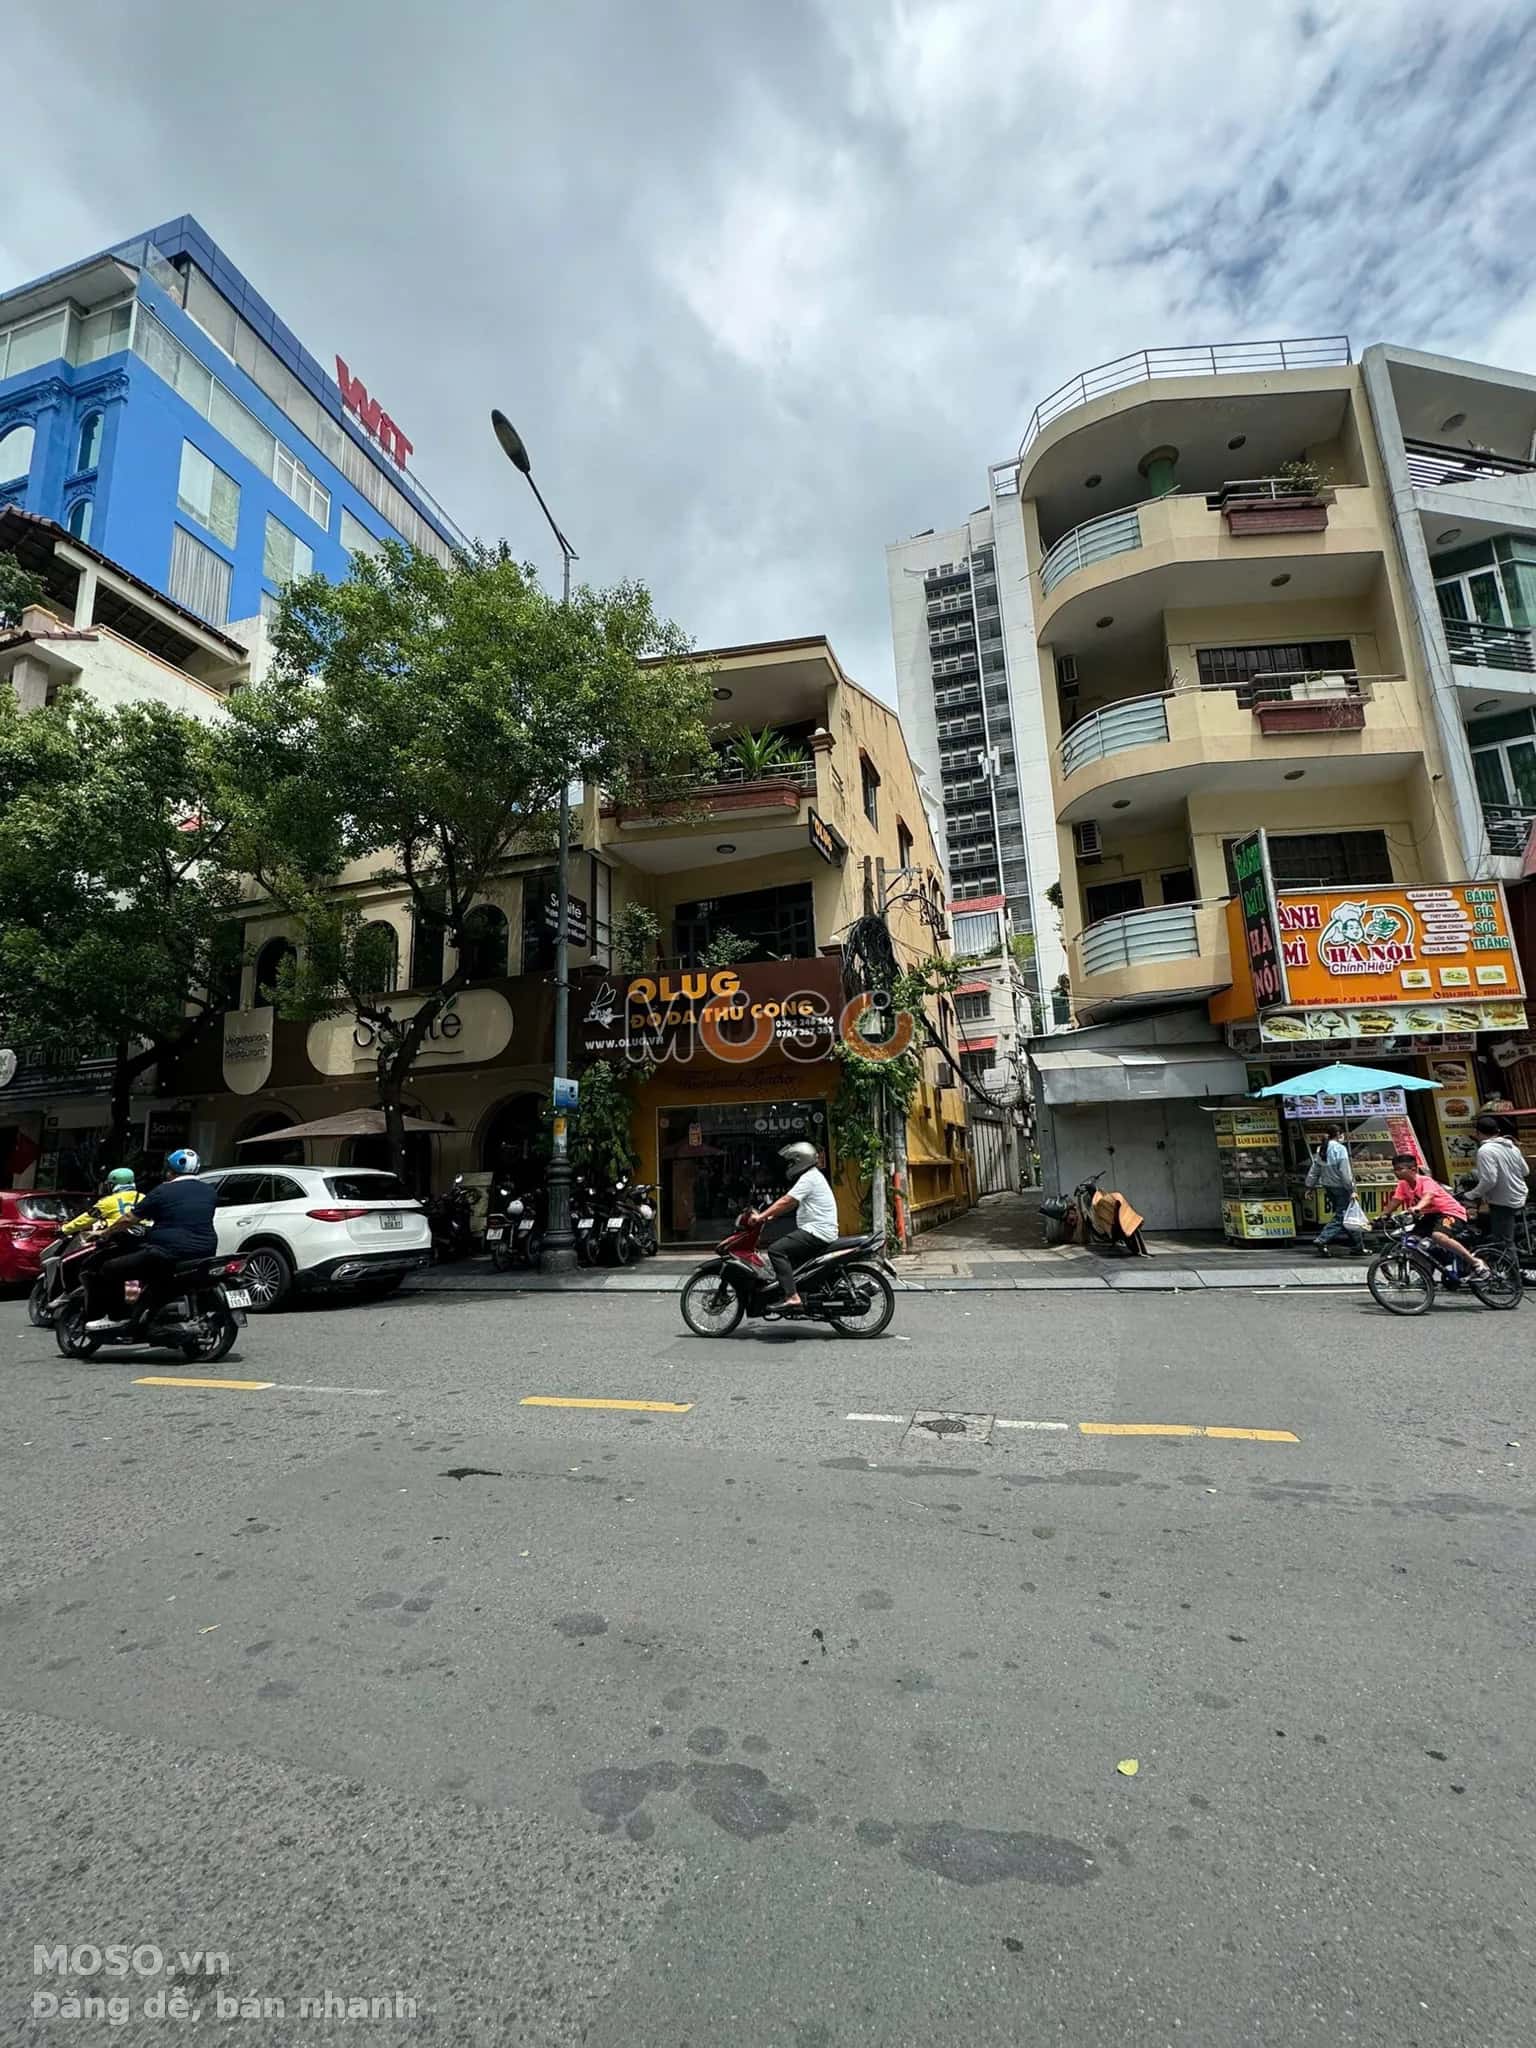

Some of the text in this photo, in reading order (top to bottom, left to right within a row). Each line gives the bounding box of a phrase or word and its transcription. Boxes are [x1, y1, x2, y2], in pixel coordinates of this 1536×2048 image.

[1466, 888, 1496, 902] BÁNH
[1277, 901, 1321, 929] ÁNH
[1476, 903, 1495, 917] PÍA
[1250, 917, 1273, 957] HÀ
[1475, 919, 1497, 934] SÓC
[1282, 936, 1309, 965] MÌ
[1328, 940, 1414, 964] HÀ NỘI
[1472, 935, 1510, 950] TRĂNG
[1331, 961, 1393, 975] Chính Hiệu
[628, 971, 741, 1004] OLUG
[1253, 960, 1281, 1001] NỘI
[667, 1009, 697, 1025] DA
[751, 997, 814, 1019] CÔNG
[754, 1117, 806, 1131] OLUG
